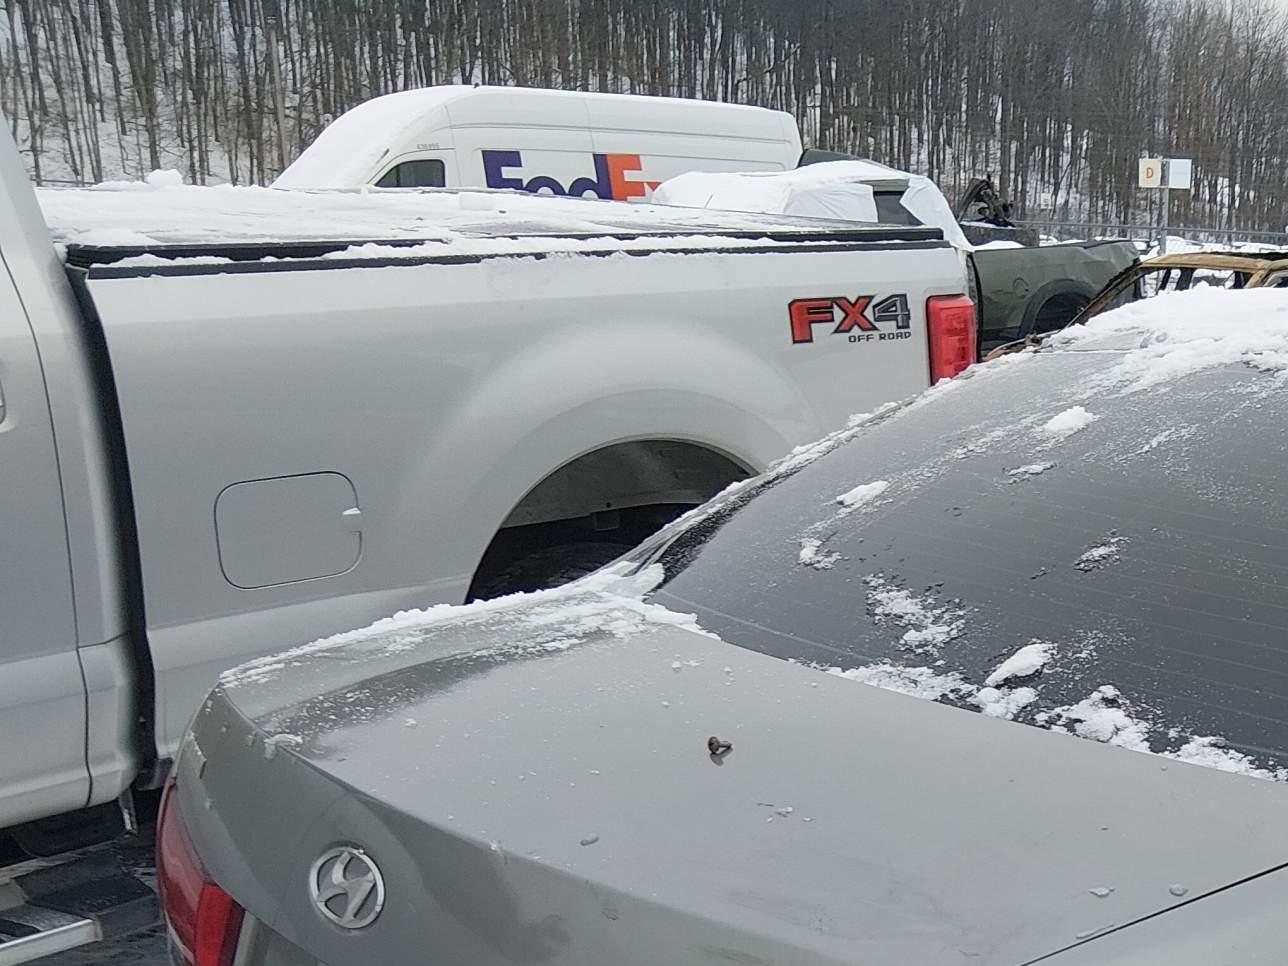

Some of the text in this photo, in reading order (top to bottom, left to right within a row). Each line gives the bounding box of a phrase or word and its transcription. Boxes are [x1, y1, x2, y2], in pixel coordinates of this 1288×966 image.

[1145, 167, 1154, 179] D
[788, 293, 911, 345] FX4
[848, 331, 912, 343] OFF ROAD
